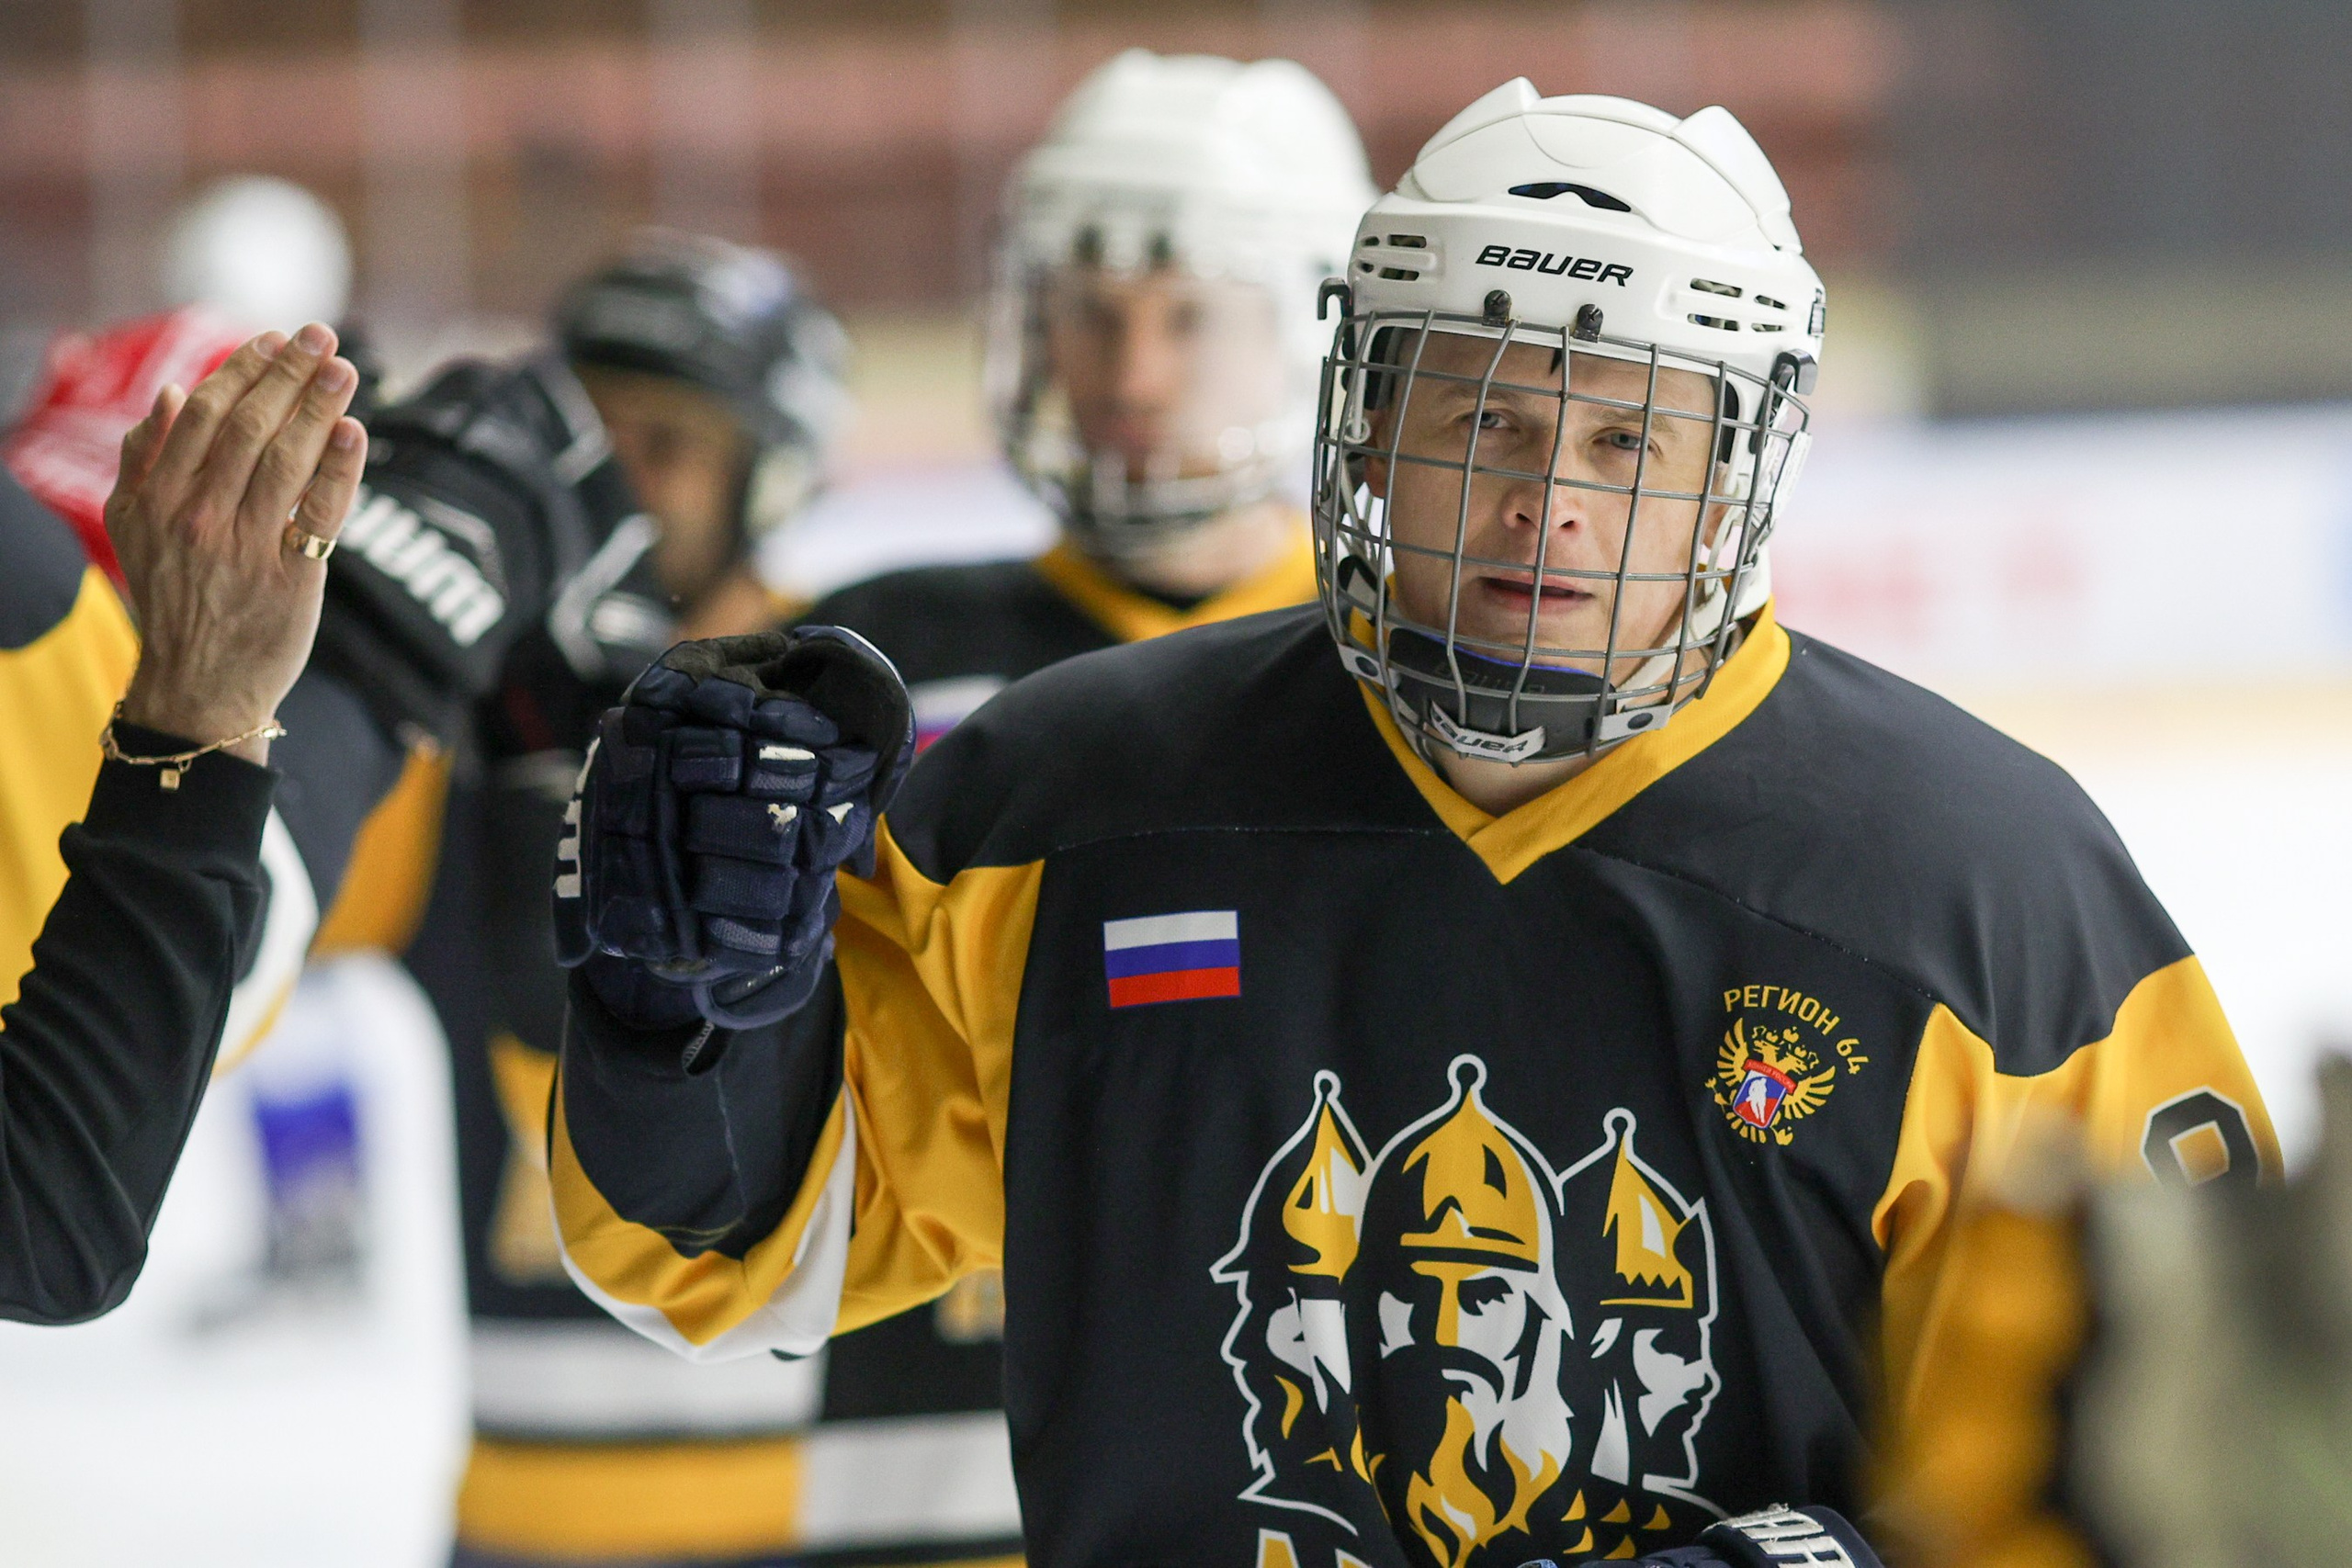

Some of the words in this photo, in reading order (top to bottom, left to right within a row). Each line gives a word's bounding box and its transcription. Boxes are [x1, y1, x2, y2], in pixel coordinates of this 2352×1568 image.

[1476, 244, 1634, 287] BAUER
[1724, 985, 1840, 1035] РЕГИОН
[1836, 1038, 1869, 1075] 64
